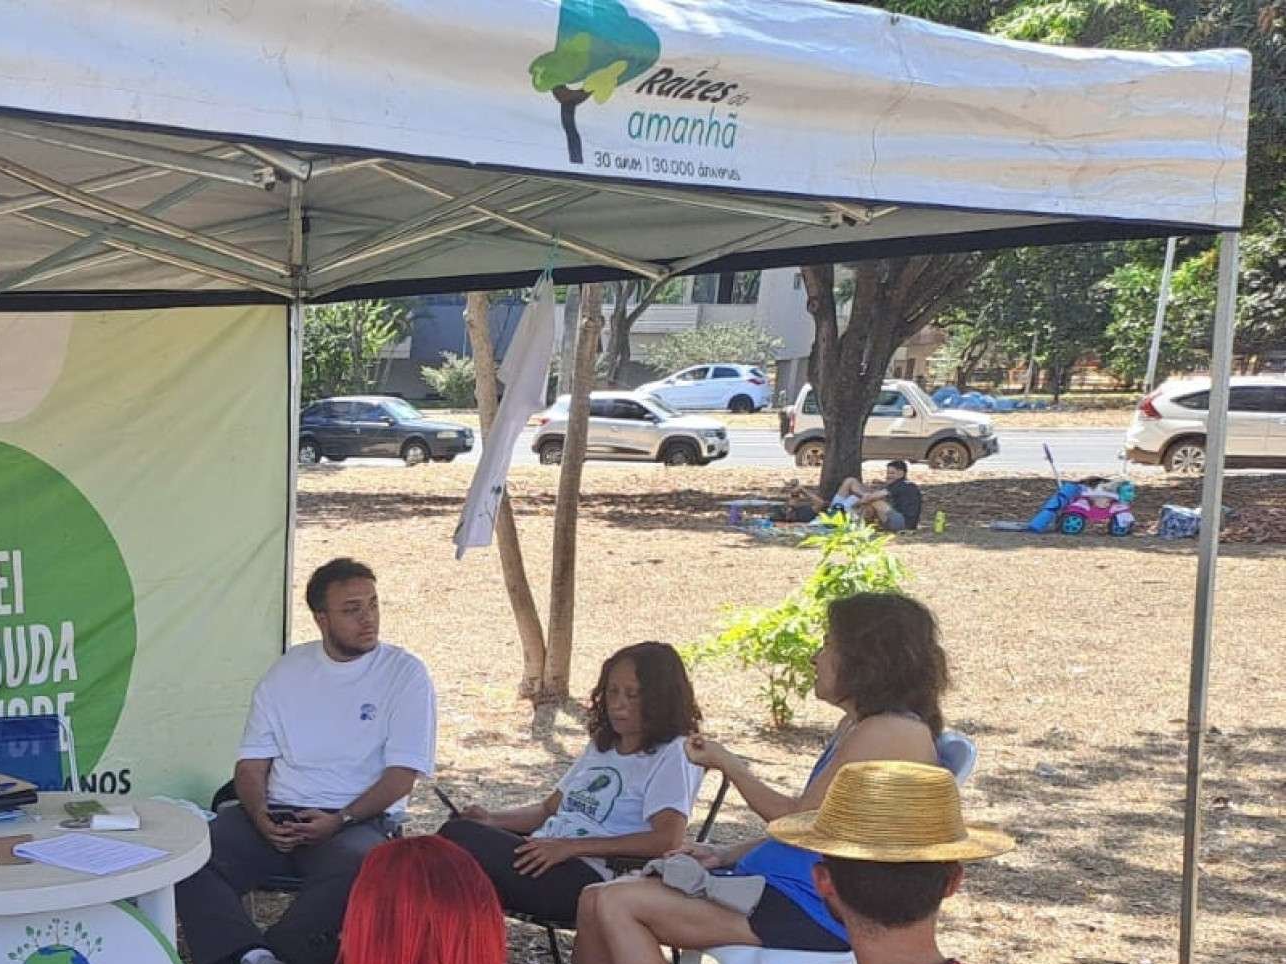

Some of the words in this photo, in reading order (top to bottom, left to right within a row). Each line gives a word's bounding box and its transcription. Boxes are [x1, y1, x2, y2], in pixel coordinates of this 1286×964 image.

[636, 67, 739, 103] Raízes
[628, 106, 738, 149] amanhã
[594, 151, 611, 168] 30
